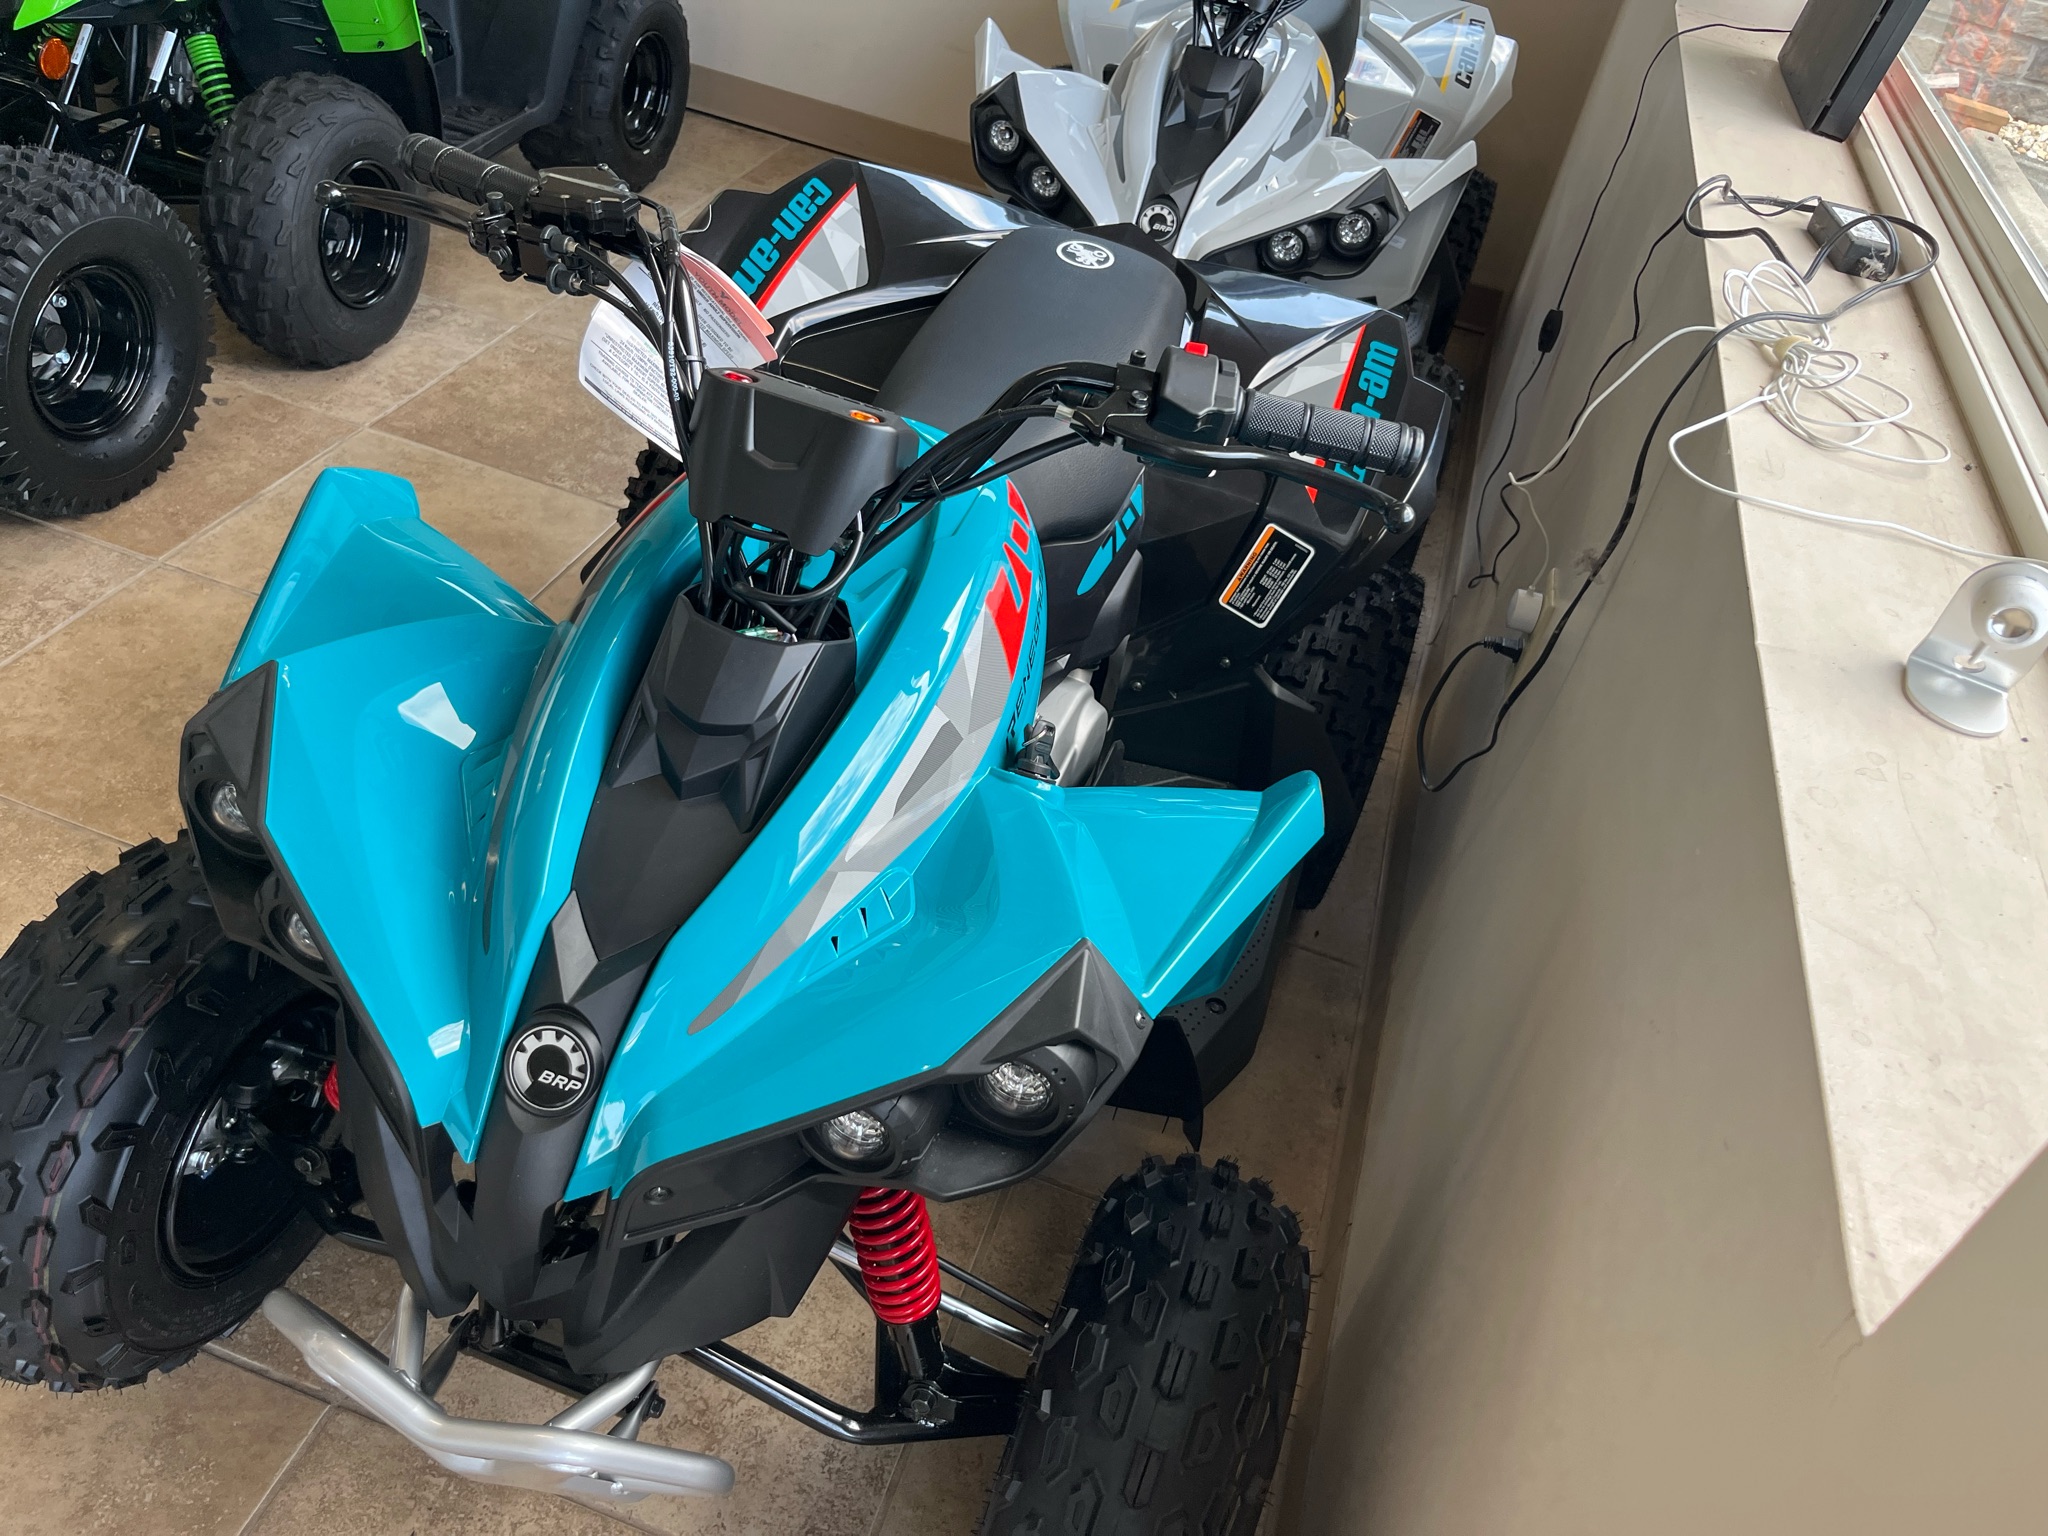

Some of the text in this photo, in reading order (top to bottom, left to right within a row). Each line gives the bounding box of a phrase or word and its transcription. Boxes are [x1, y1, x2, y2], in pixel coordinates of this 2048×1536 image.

[1152, 223, 1173, 233] BRP
[692, 270, 744, 327] YOUTH MODEL
[1239, 552, 1258, 579] WARNING
[537, 1069, 583, 1092] BRP
